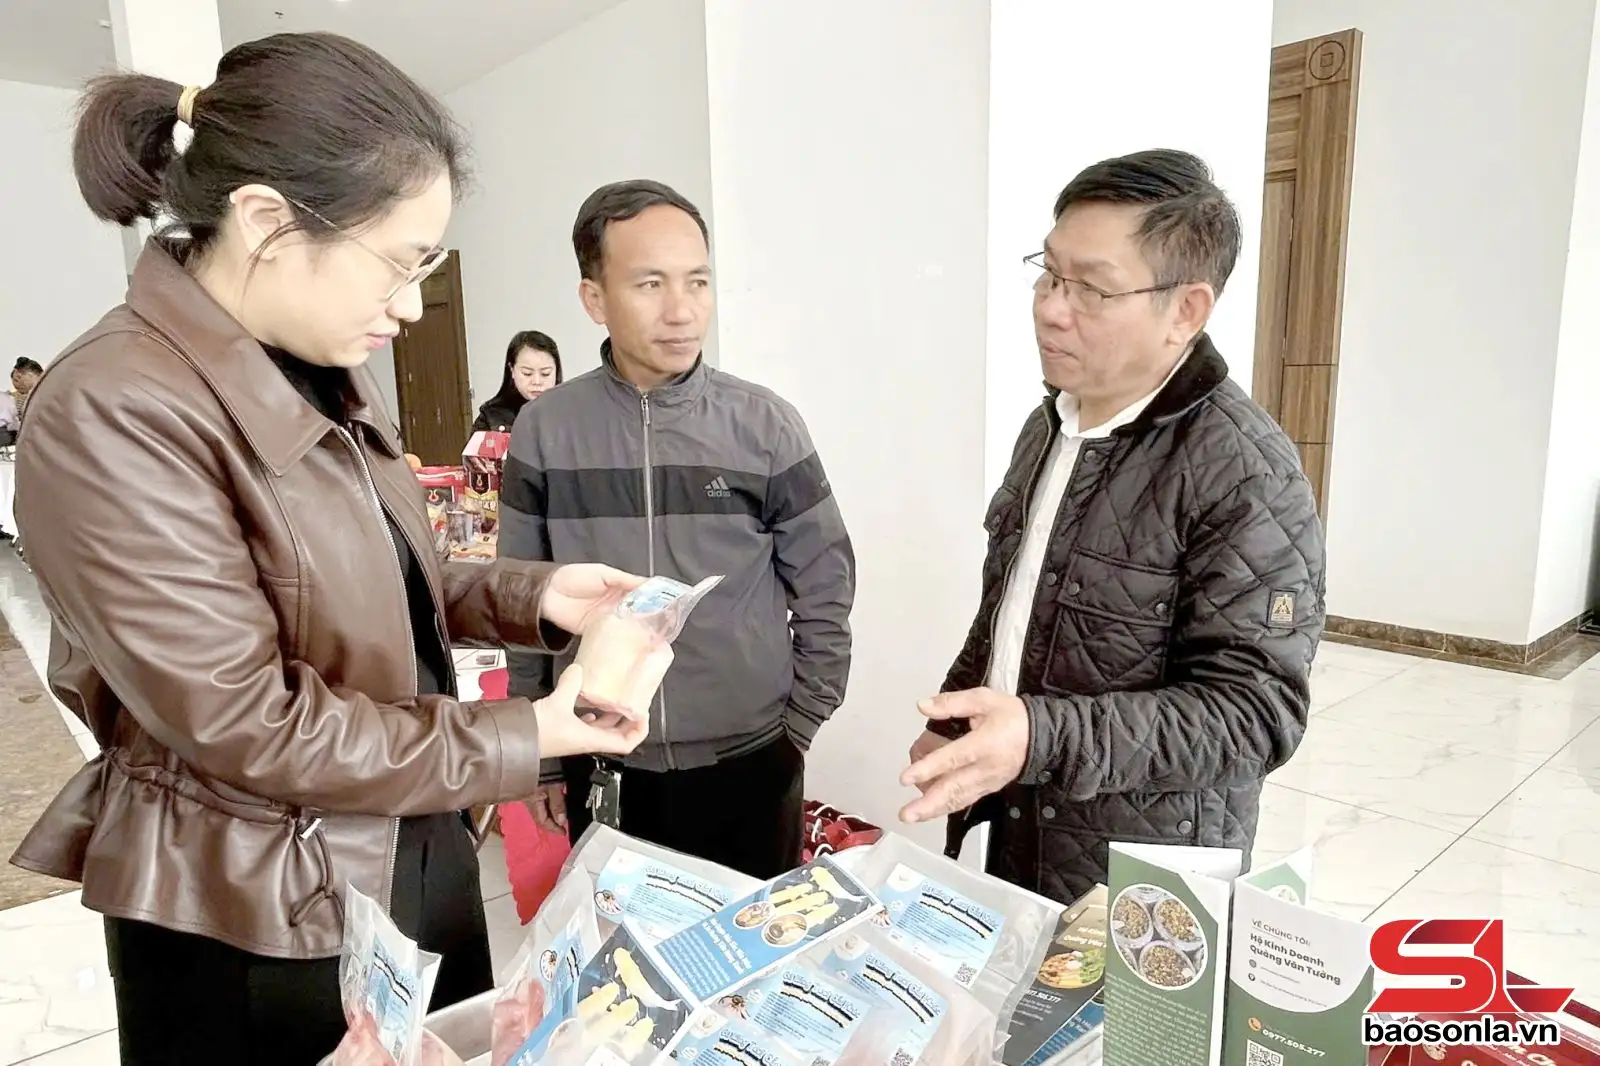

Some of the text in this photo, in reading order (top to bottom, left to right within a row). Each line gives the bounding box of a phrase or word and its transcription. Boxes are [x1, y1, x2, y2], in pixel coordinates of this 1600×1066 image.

[1263, 923, 1293, 940] CHÚNG
[1250, 932, 1325, 968] Hộ Kinh Doanh
[1284, 958, 1305, 972] Văn
